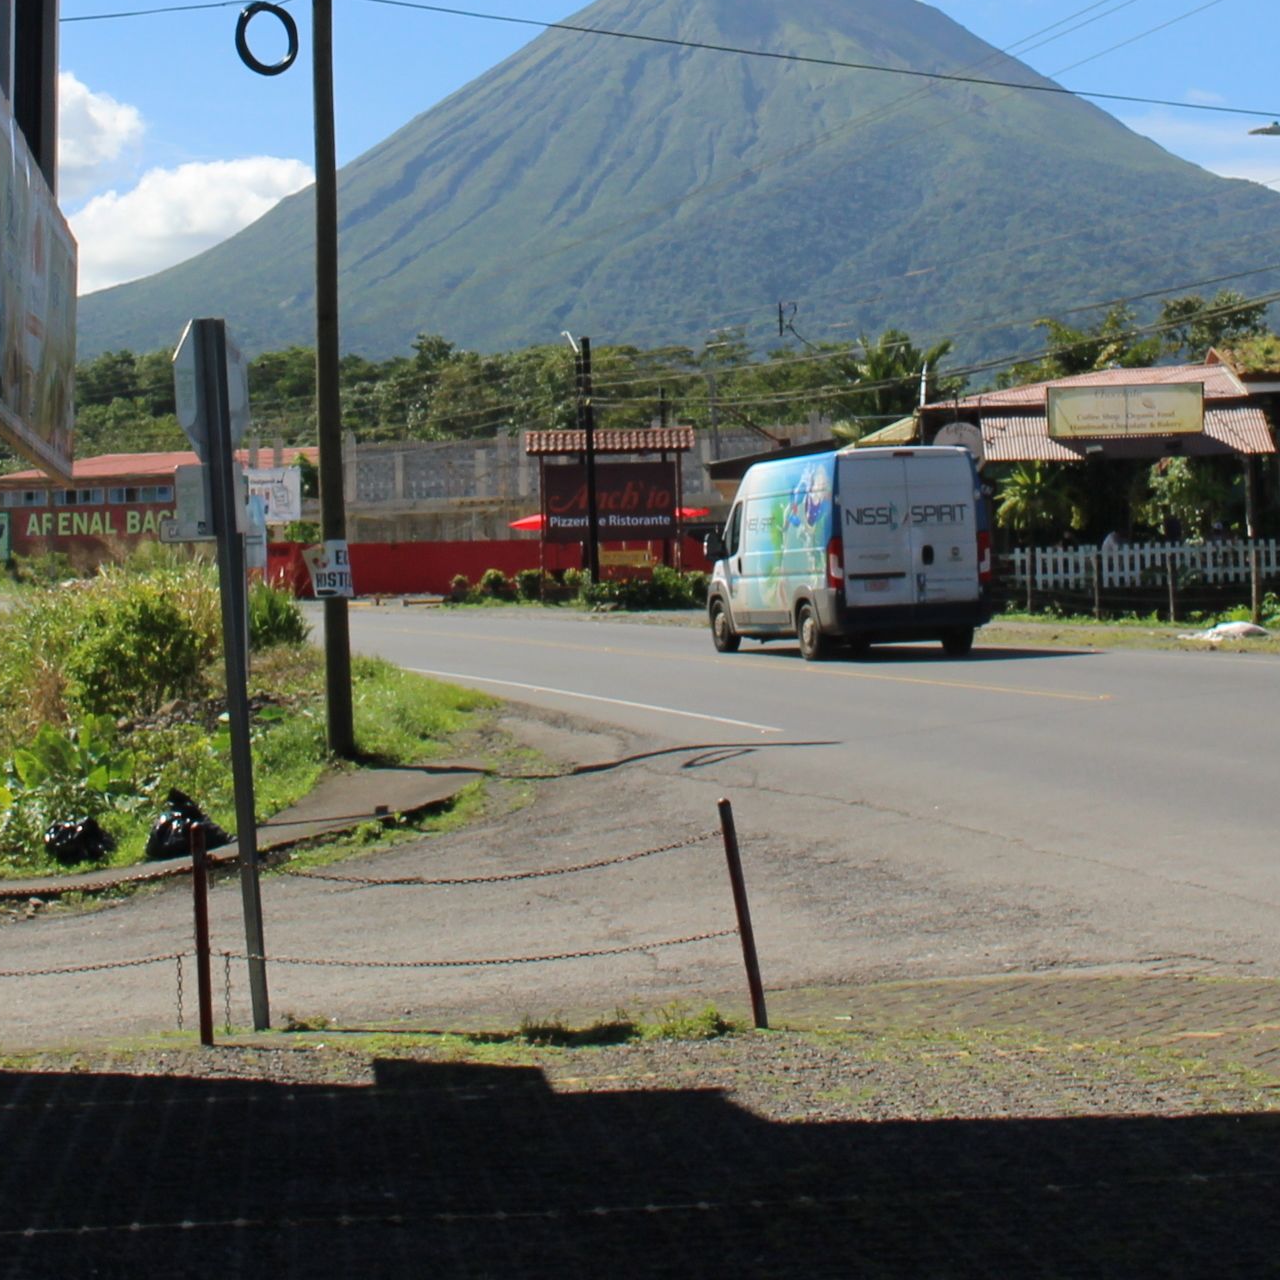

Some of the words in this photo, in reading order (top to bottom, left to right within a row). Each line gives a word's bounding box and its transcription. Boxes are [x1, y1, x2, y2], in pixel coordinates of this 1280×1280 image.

[26, 511, 117, 536] ARENAL
[550, 516, 591, 527] Pizzeri
[608, 515, 671, 527] Ristorante
[846, 506, 894, 526] NISSI
[911, 503, 968, 524] SPIRIT
